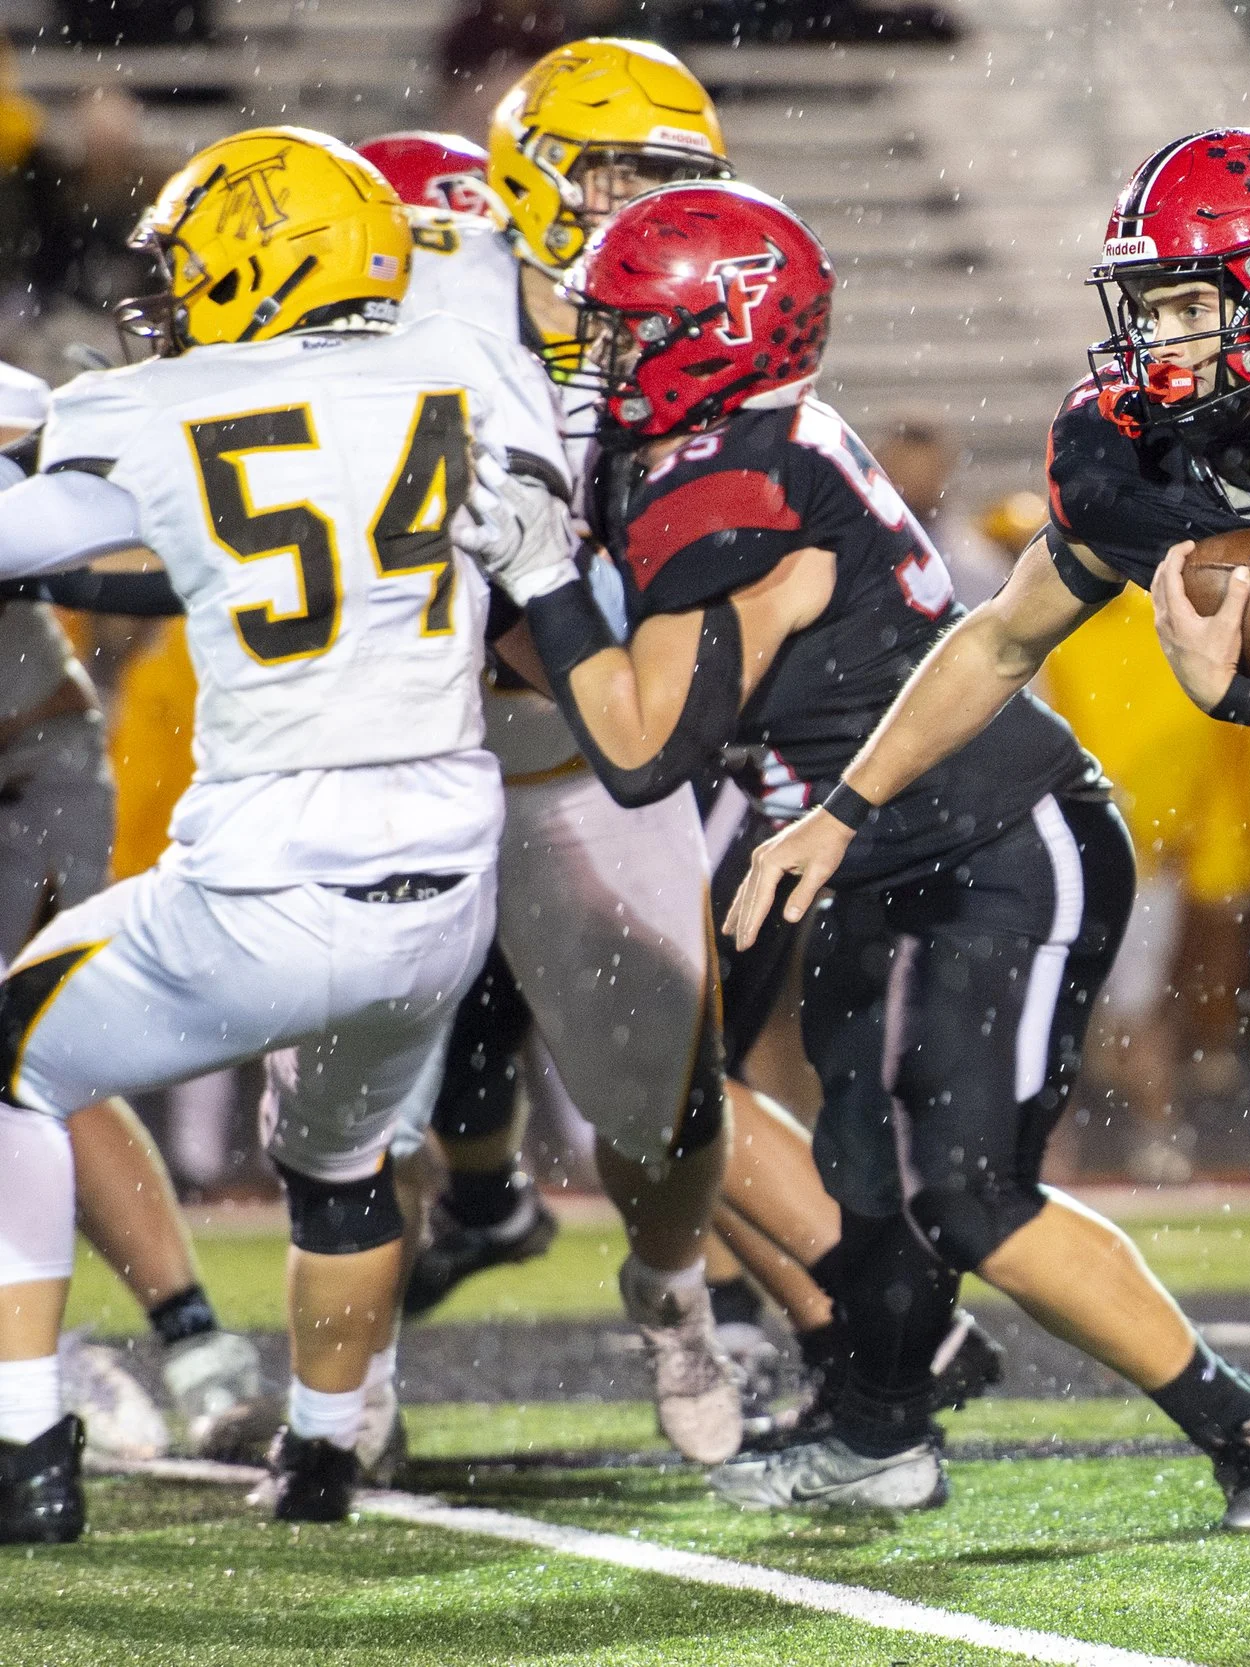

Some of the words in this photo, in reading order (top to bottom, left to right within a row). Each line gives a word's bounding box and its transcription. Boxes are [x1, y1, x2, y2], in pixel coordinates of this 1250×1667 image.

[1105, 241, 1146, 256] Riddell
[704, 252, 777, 346] F
[180, 388, 471, 667] 54
